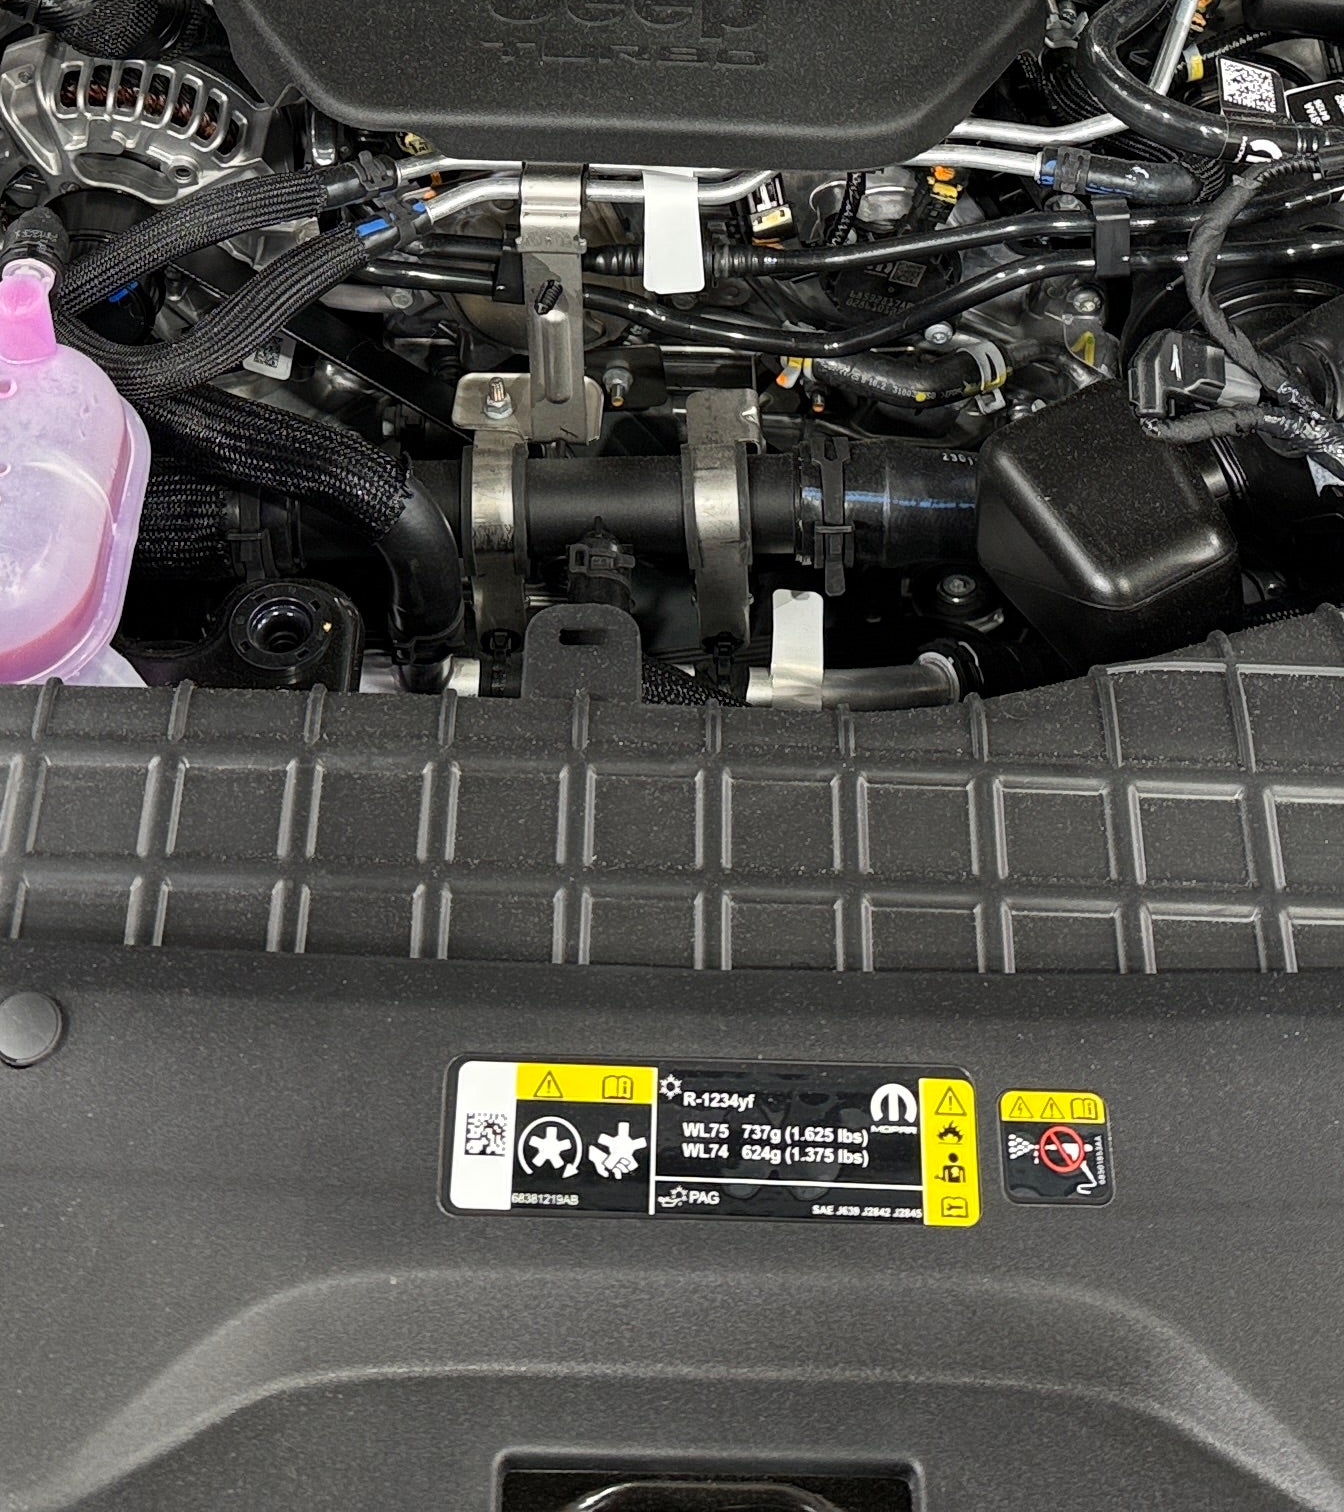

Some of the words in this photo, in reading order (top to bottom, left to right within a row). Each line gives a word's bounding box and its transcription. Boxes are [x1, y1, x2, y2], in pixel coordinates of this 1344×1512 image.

[480, 41, 766, 68] TURBO
[682, 1091, 755, 1112] R-1234yf
[682, 1122, 730, 1139] WL75
[741, 1124, 782, 1144] 737g
[784, 1126, 834, 1145] (1.625
[837, 1128, 869, 1148] lbs)
[681, 1143, 730, 1159] WL74
[741, 1145, 782, 1165] 624g
[784, 1146, 834, 1165] (1.375
[837, 1148, 870, 1168] lbs)
[688, 1190, 721, 1205] PAG
[812, 1204, 834, 1216] SAE
[835, 1205, 861, 1217] J639
[861, 1206, 892, 1218] J2842
